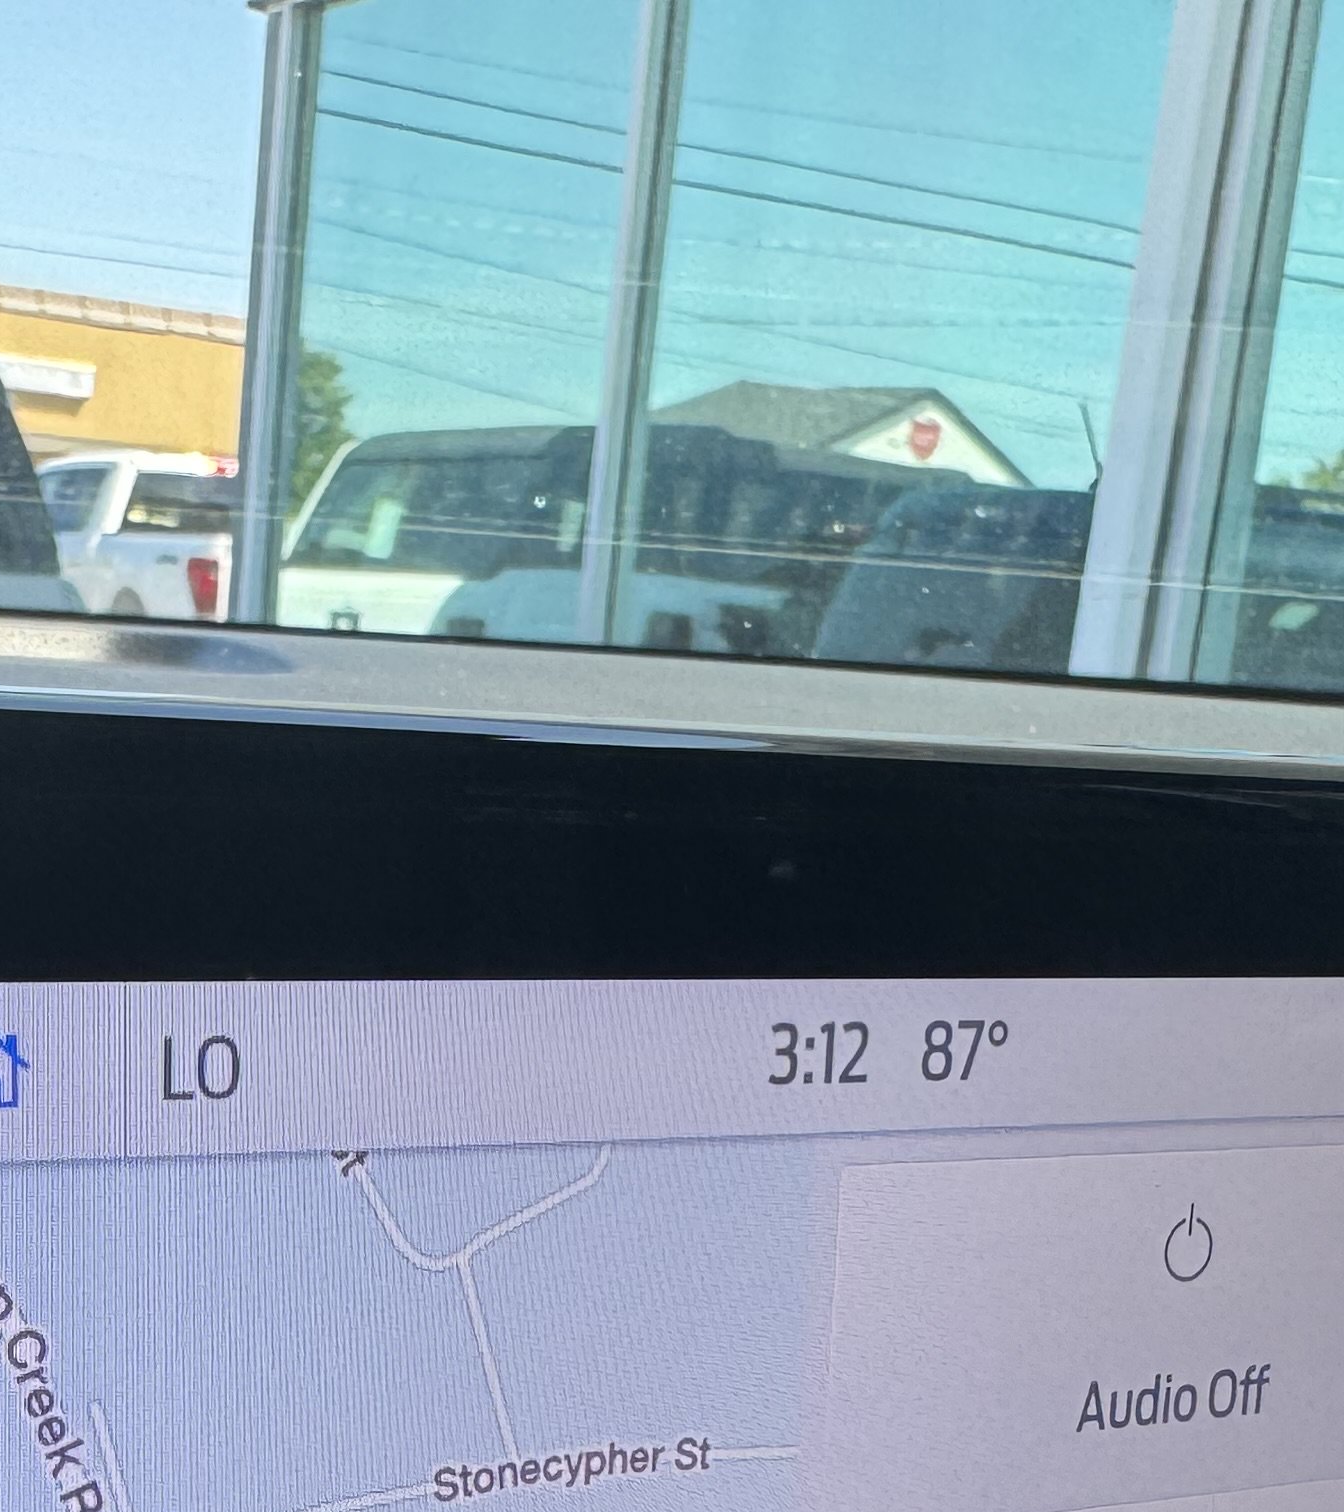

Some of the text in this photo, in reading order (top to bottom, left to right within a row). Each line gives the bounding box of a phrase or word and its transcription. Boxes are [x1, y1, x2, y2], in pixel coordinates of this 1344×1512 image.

[161, 1034, 242, 1103] LO
[767, 1022, 870, 1086] 3:12
[7, 1330, 86, 1480] Creek
[1076, 1364, 1272, 1434] Audio Off
[433, 1437, 712, 1503] Stonecypher St
